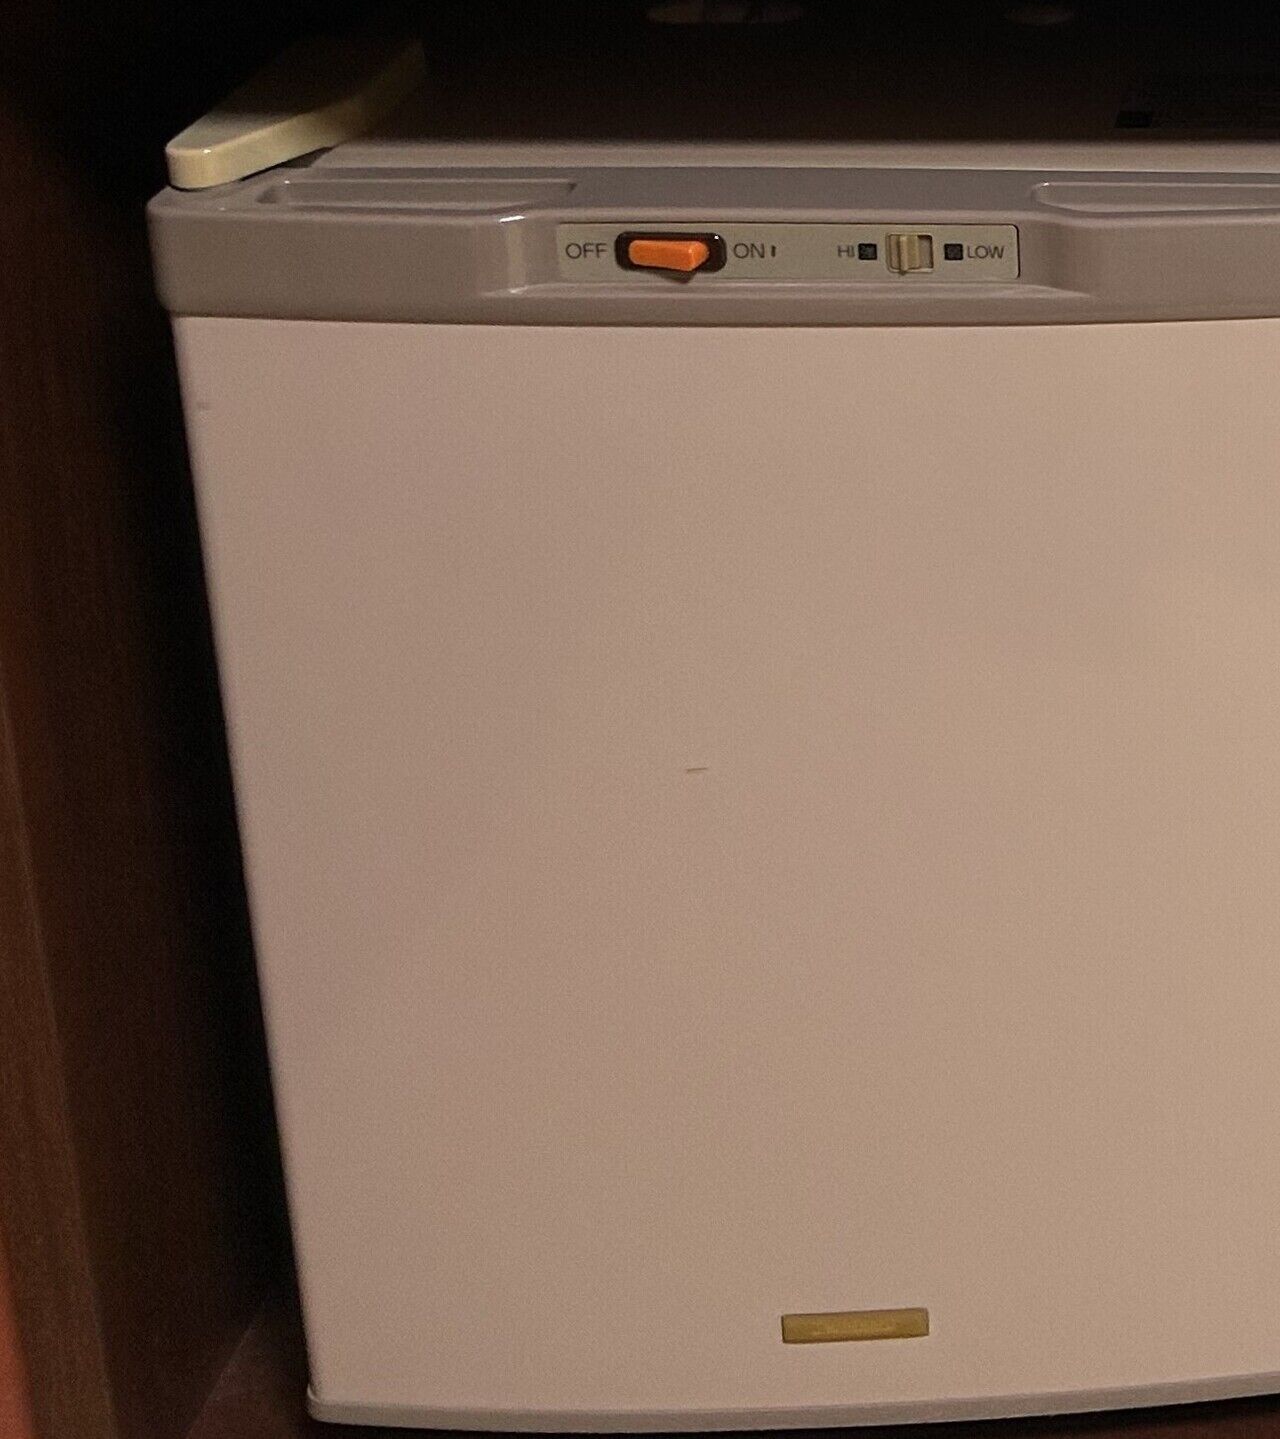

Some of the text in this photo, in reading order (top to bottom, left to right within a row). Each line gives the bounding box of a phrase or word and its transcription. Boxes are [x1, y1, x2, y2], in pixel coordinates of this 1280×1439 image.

[565, 242, 768, 260] OFF ON
[837, 243, 1005, 260] HI LOW
